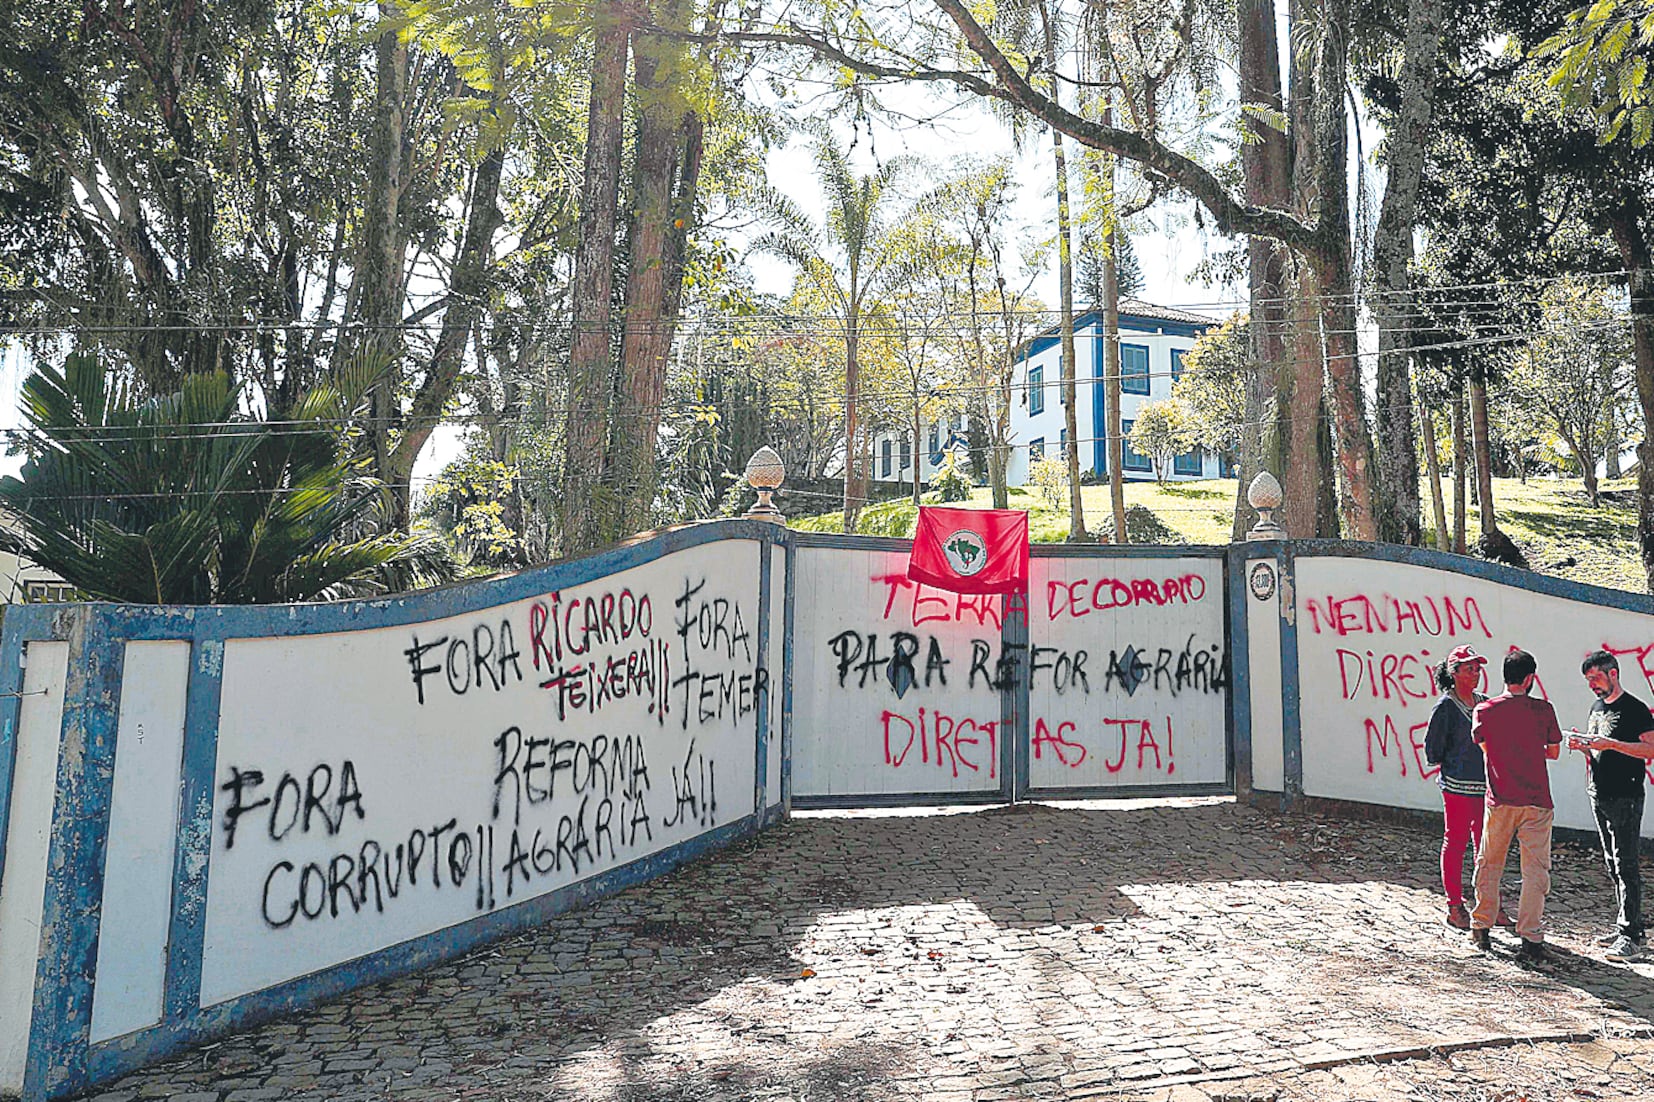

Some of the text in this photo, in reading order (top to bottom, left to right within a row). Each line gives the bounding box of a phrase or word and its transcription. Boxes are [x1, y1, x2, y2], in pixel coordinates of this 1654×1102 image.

[675, 576, 751, 662] FORA
[1306, 594, 1493, 638] NENHUM
[404, 619, 523, 704] FORA
[829, 631, 950, 690] PARA
[494, 726, 650, 826] REFORMA
[1103, 715, 1176, 775] JA!
[221, 760, 366, 850] FORA
